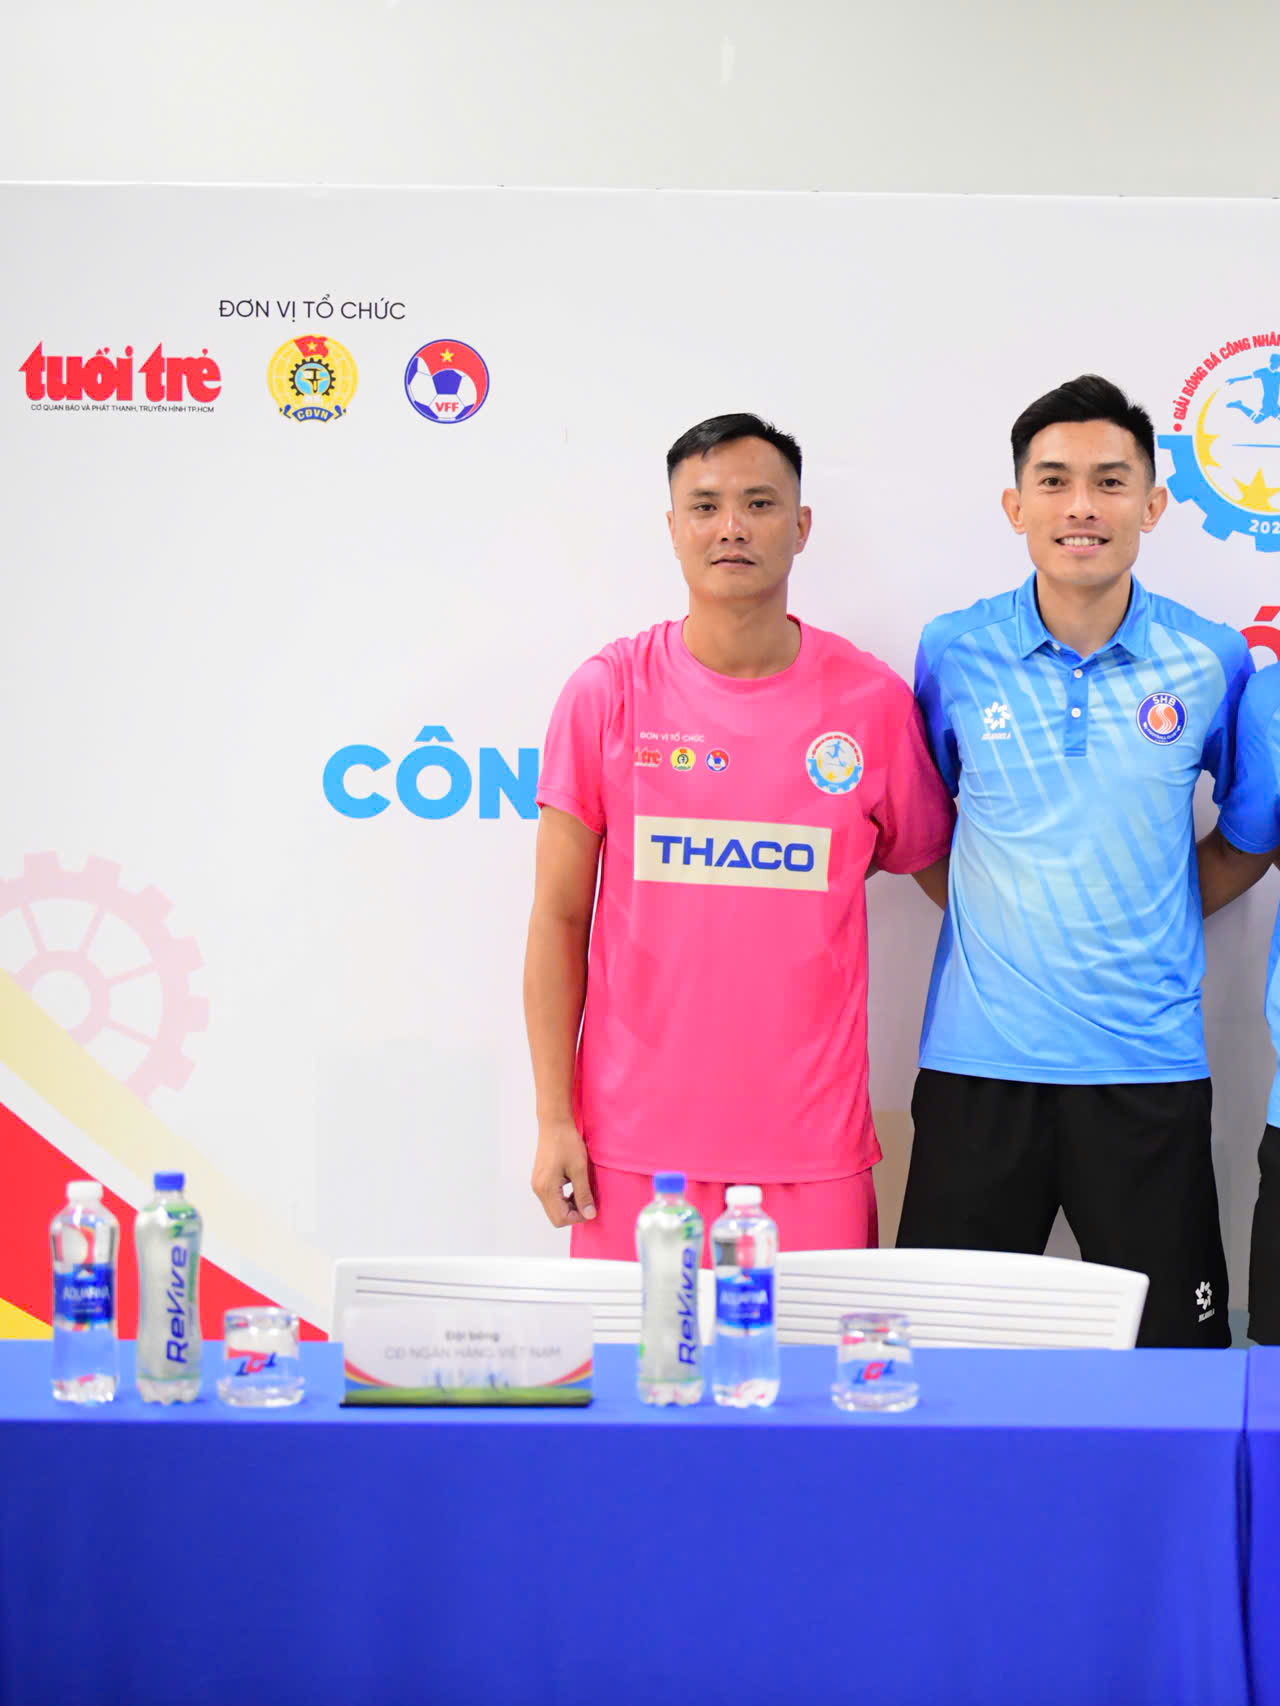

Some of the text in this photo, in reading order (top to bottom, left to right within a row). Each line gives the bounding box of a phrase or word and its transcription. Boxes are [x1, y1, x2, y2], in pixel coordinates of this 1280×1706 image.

[219, 294, 407, 323] ĐƠN VỊ TỔ CHỨC
[1219, 337, 1251, 360] CÔNG
[18, 341, 222, 404] tuổi trẻ
[1203, 351, 1222, 371] ĐÁ
[1181, 366, 1208, 397] BÓNG
[91, 403, 110, 412] PHÁT
[435, 402, 459, 412] VFF
[1173, 396, 1190, 420] GIẢI
[1152, 696, 1176, 706] SHB
[323, 725, 539, 820] CÔN
[651, 834, 814, 873] THACO
